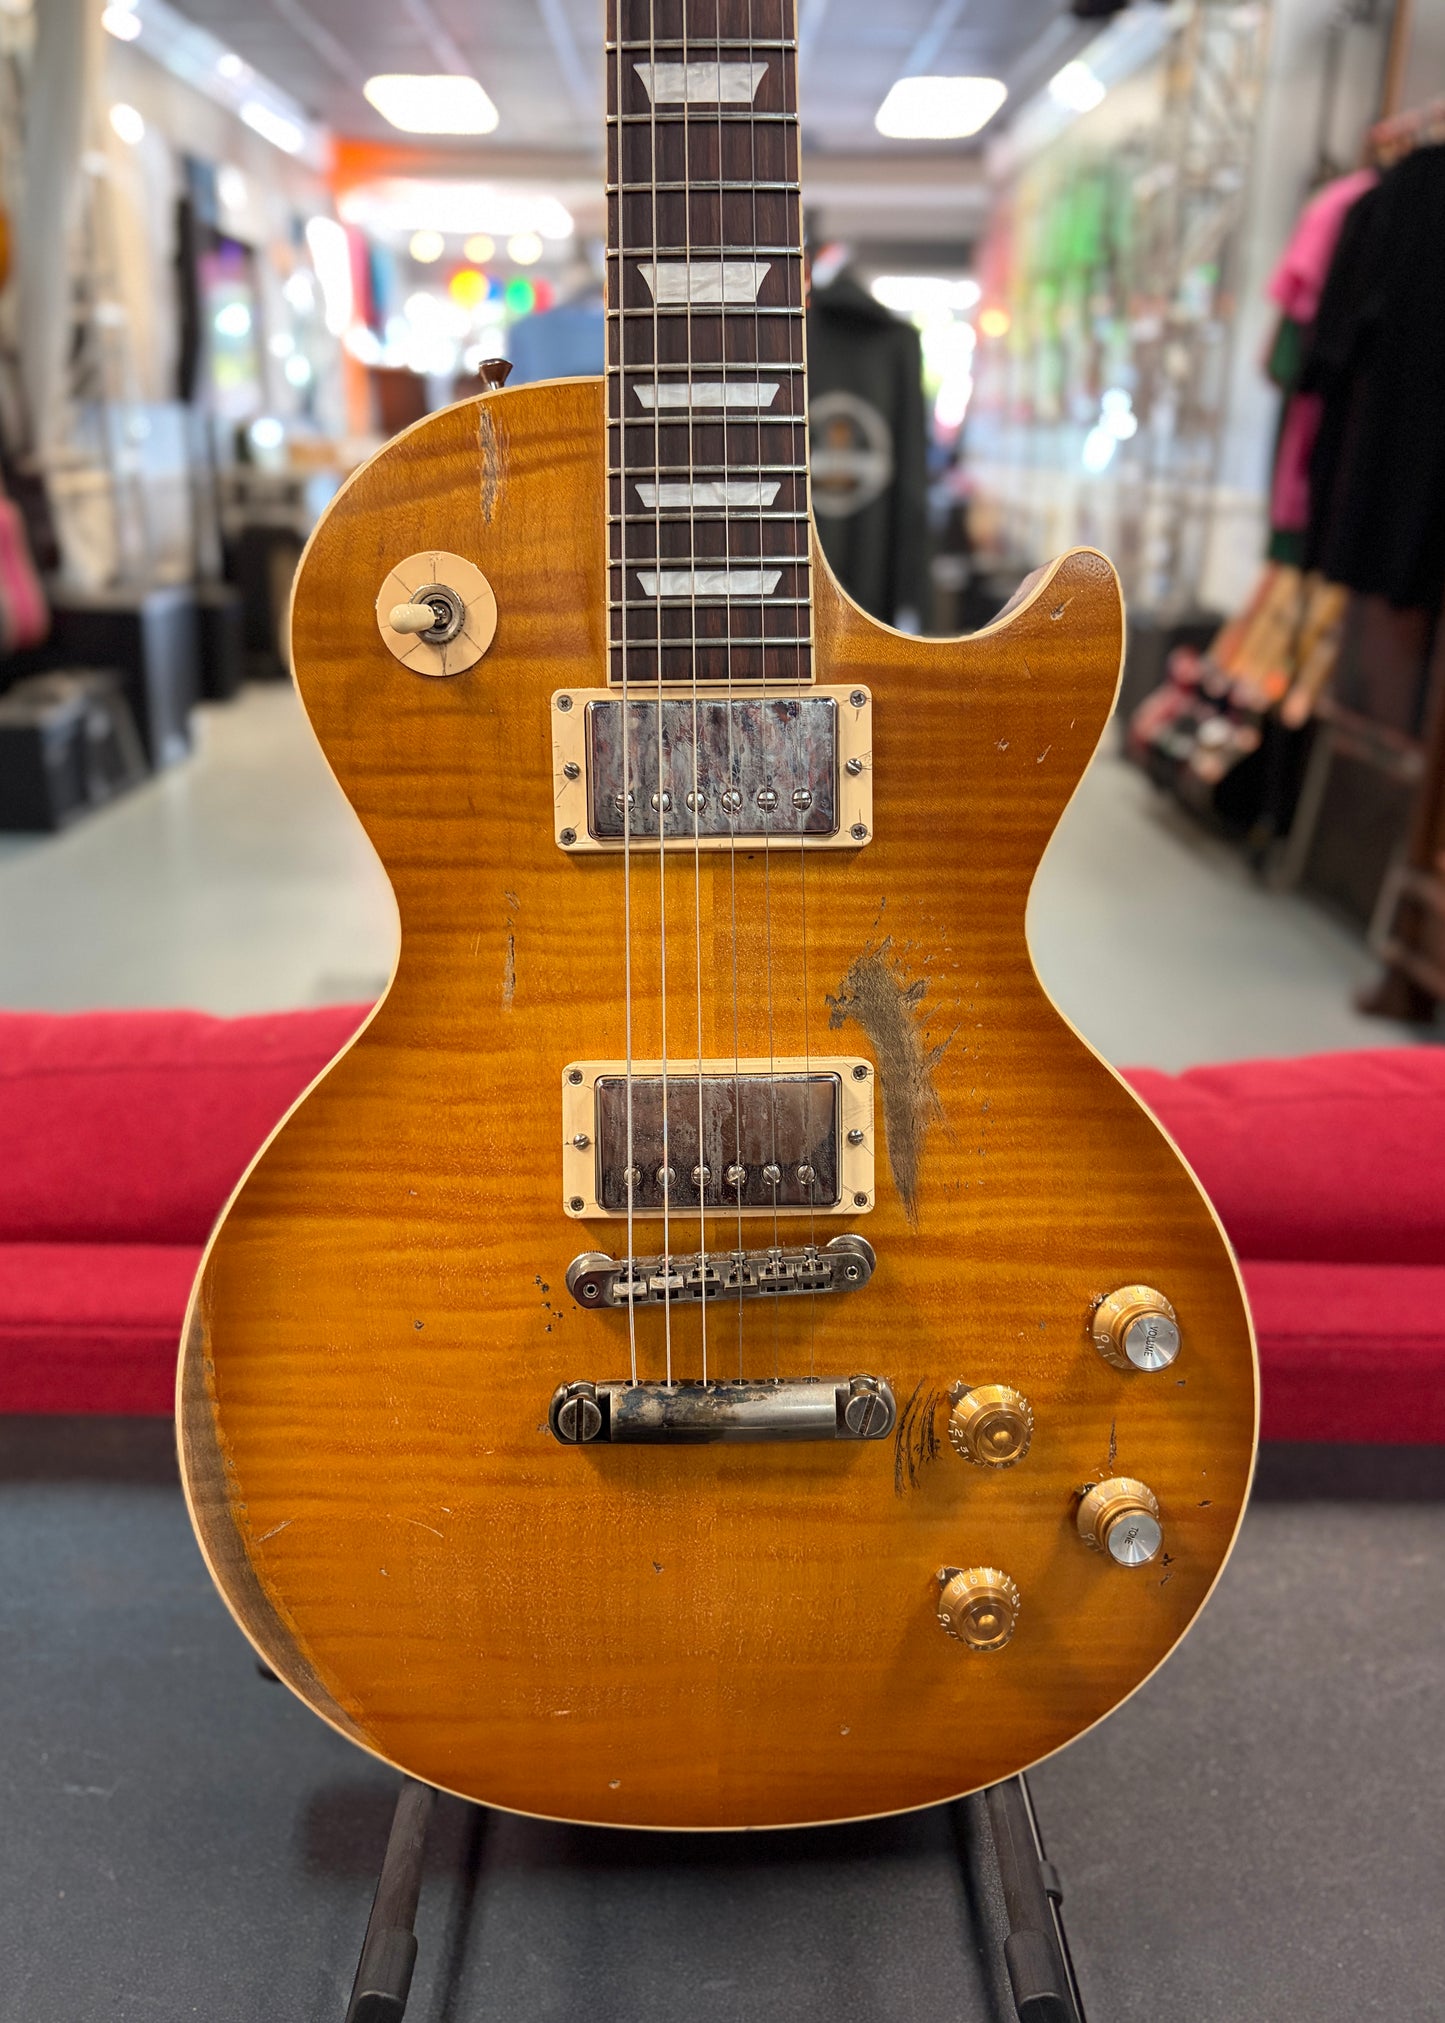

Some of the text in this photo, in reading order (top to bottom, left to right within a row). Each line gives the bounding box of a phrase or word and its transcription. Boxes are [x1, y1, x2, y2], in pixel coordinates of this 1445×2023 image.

[1143, 1326, 1158, 1357] VOLUME
[954, 1428, 964, 1438] 2
[1124, 1527, 1139, 1545] TONE
